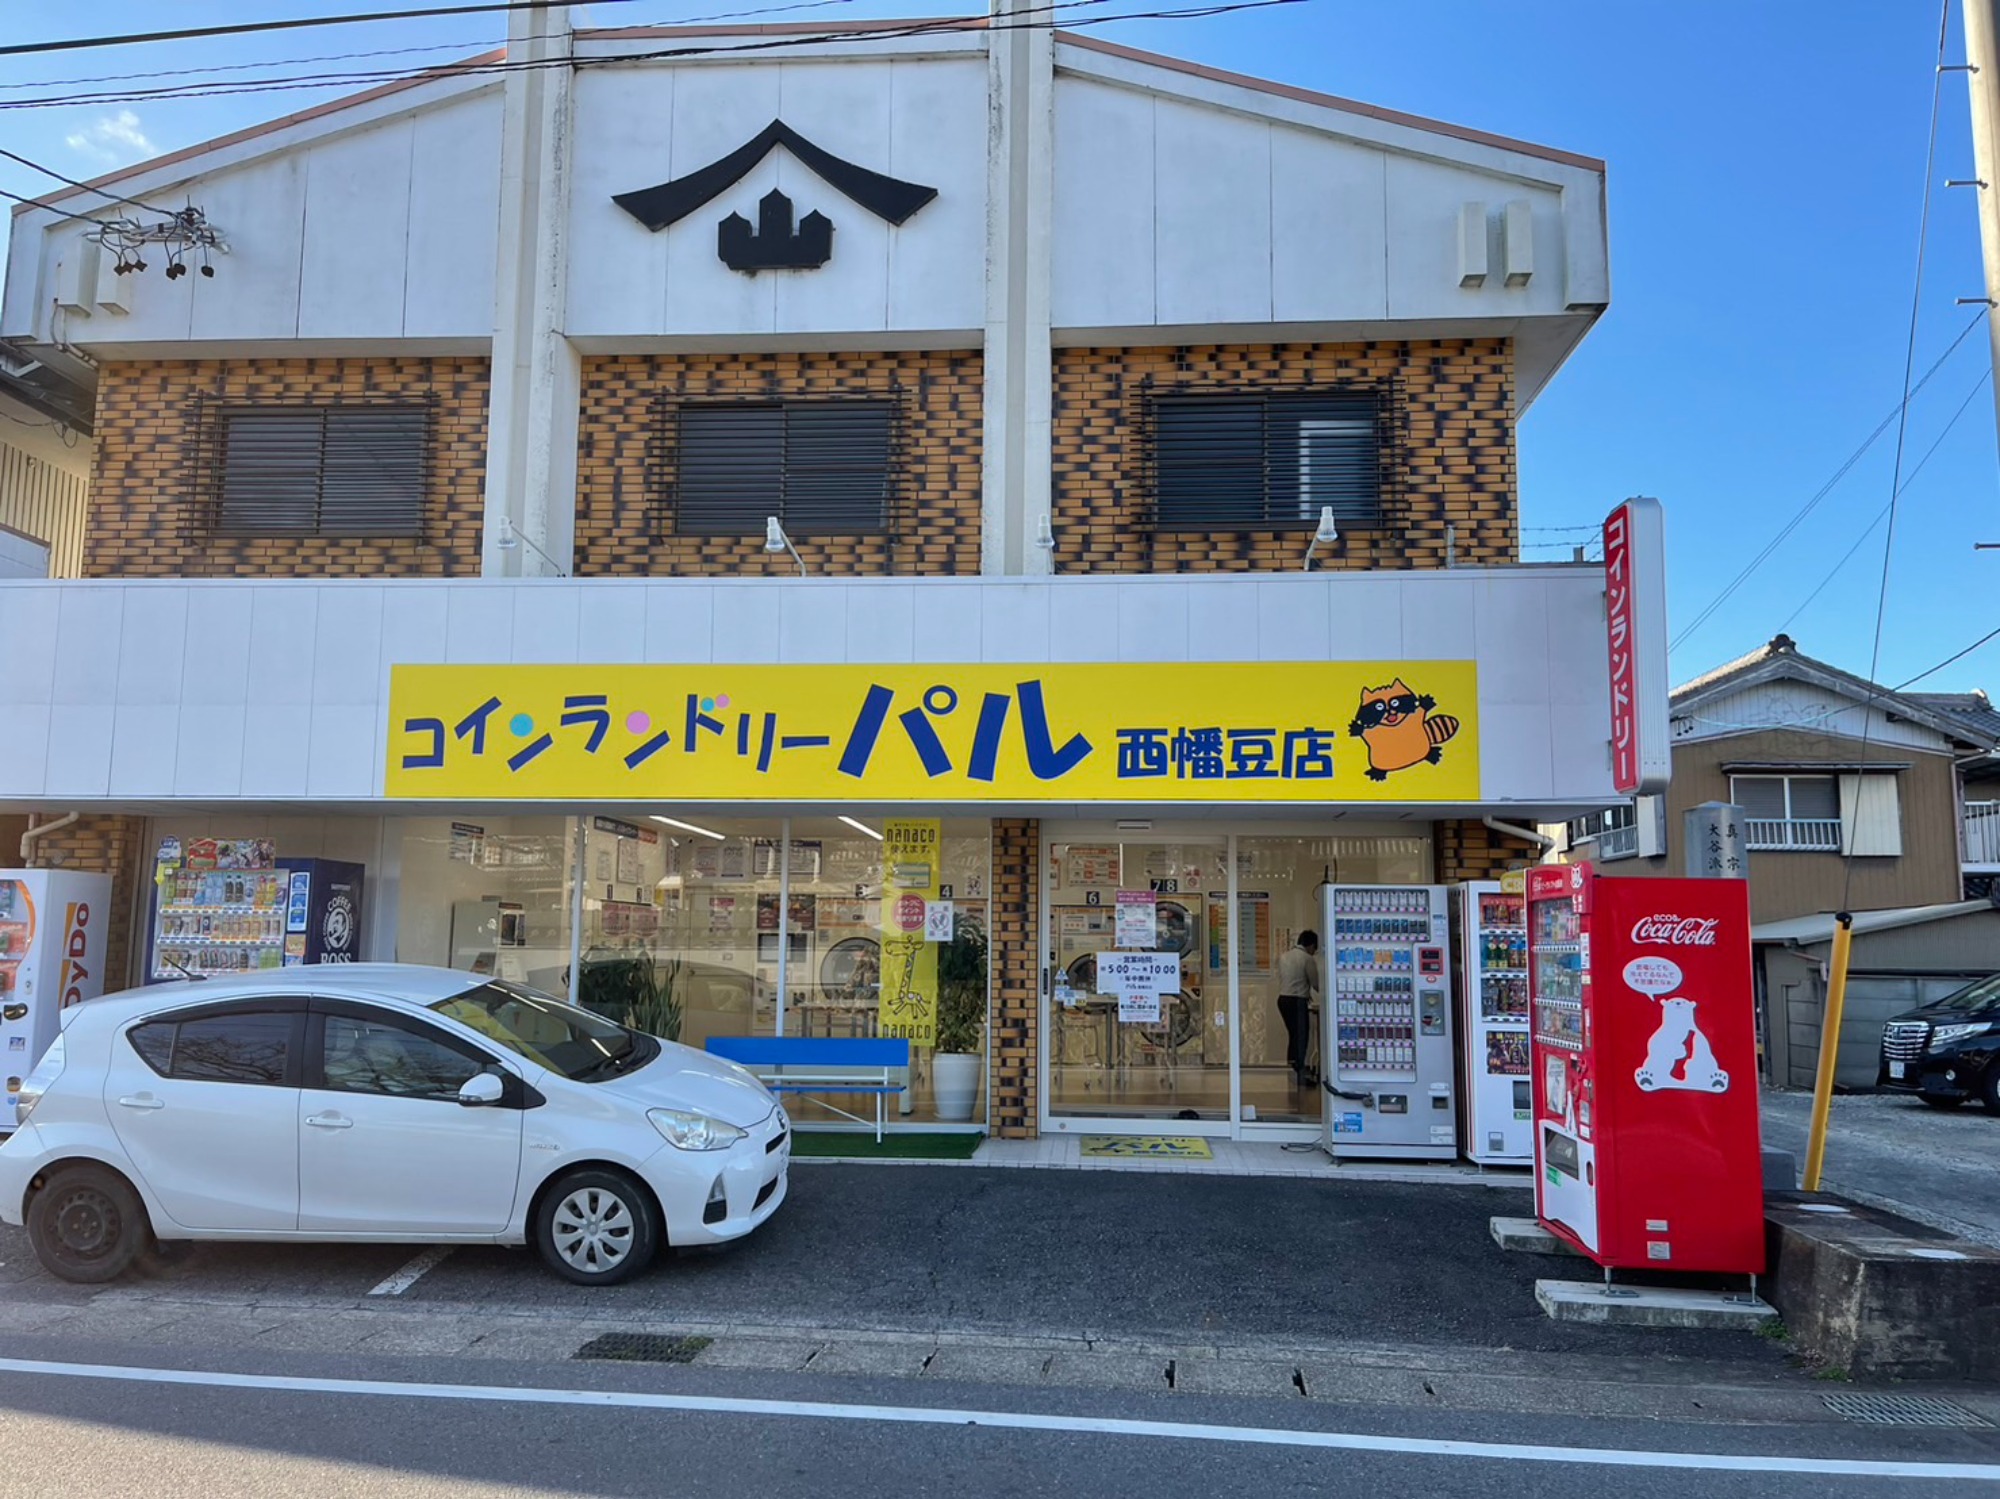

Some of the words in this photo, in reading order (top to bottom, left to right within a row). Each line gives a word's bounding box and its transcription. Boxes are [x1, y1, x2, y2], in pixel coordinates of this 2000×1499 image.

[1607, 516, 1629, 780] コインランドリー
[402, 691, 831, 774] コインランドリー
[838, 680, 1094, 783] パル
[1116, 727, 1336, 780] 西幡豆店
[887, 828, 935, 844] nanaco
[1707, 823, 1723, 870] 大谷派
[1726, 823, 1740, 871] 真宗
[942, 886, 950, 897] 4
[1153, 880, 1161, 891] 7
[1166, 880, 1175, 892] 8
[327, 896, 352, 912] COFFEE
[1088, 892, 1098, 904] 6
[1630, 916, 1719, 945] Coca-Cola
[320, 952, 352, 964] BOSS
[882, 1023, 931, 1039] nanaco
